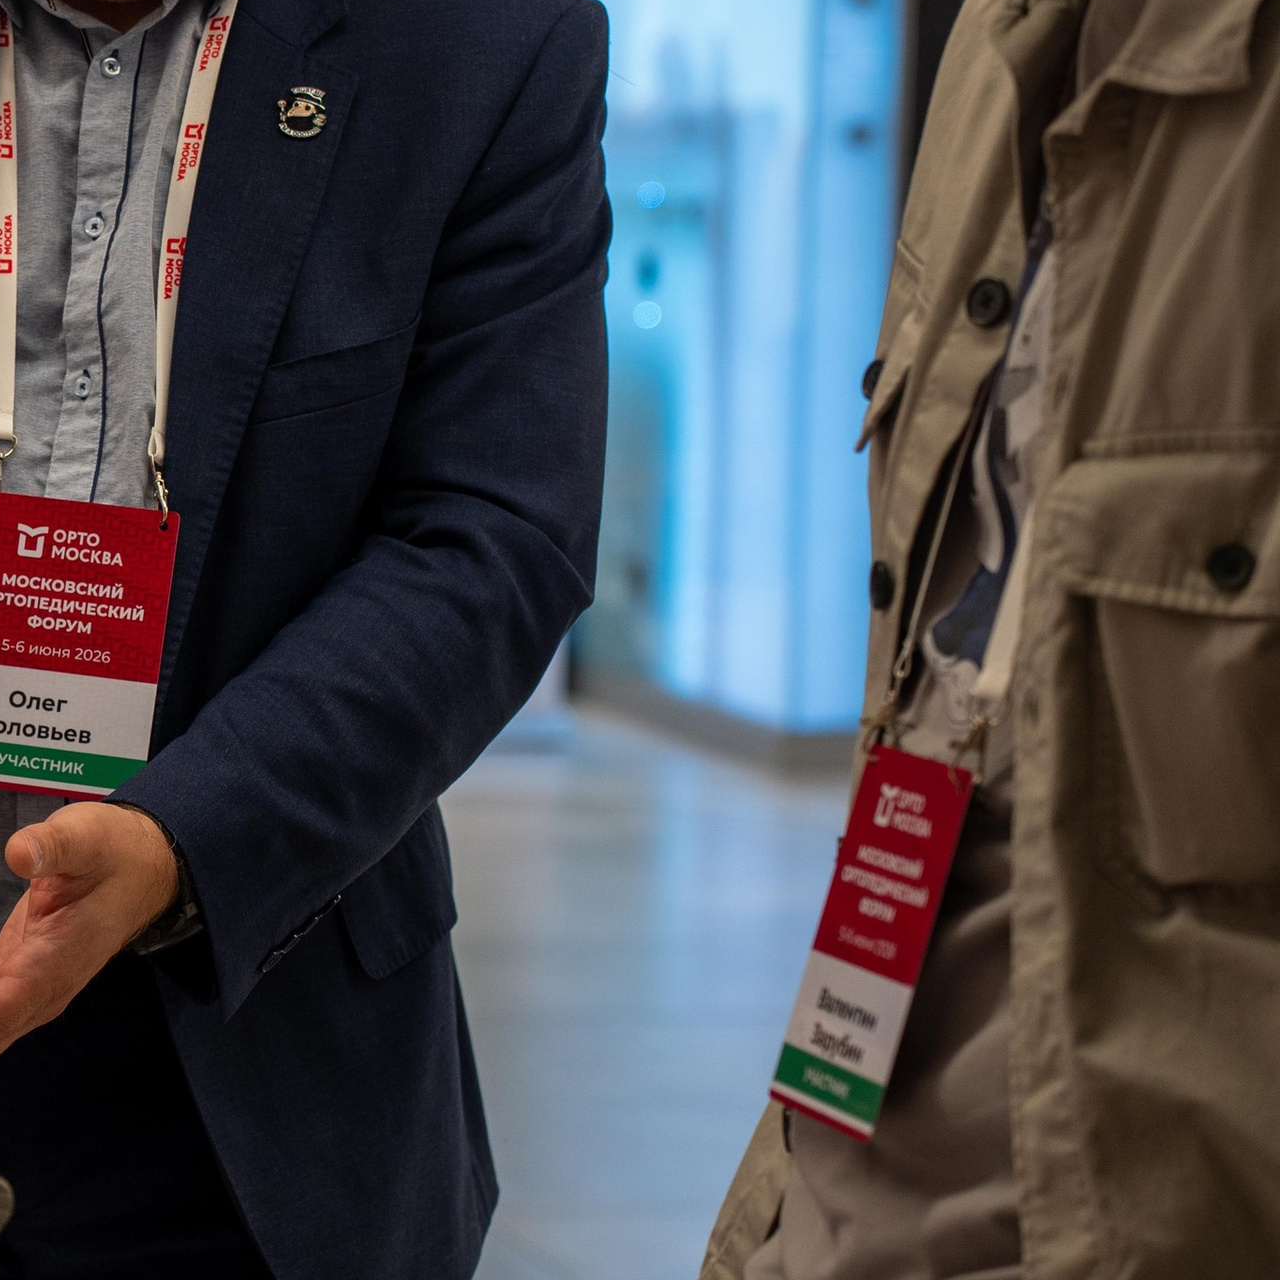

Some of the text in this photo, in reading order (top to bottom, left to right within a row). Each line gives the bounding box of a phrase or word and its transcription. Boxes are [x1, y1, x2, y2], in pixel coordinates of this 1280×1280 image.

[199, 34, 215, 71] МОСКВА
[211, 34, 224, 58] ОРТО
[3, 101, 12, 140] МОСКВА
[176, 142, 191, 181] МОСКВА
[189, 142, 200, 167] ОРТО
[4, 214, 12, 255] МОСКВА
[164, 258, 174, 299] МОСКВА
[53, 529, 100, 547] ОРТО
[51, 545, 123, 566] МОСКВА
[1, 572, 124, 600] МОСКОВСКИЙ
[27, 615, 92, 634] ФОРУМ
[1, 638, 111, 663] 5-6 июня 2026
[8, 690, 68, 713] Олег
